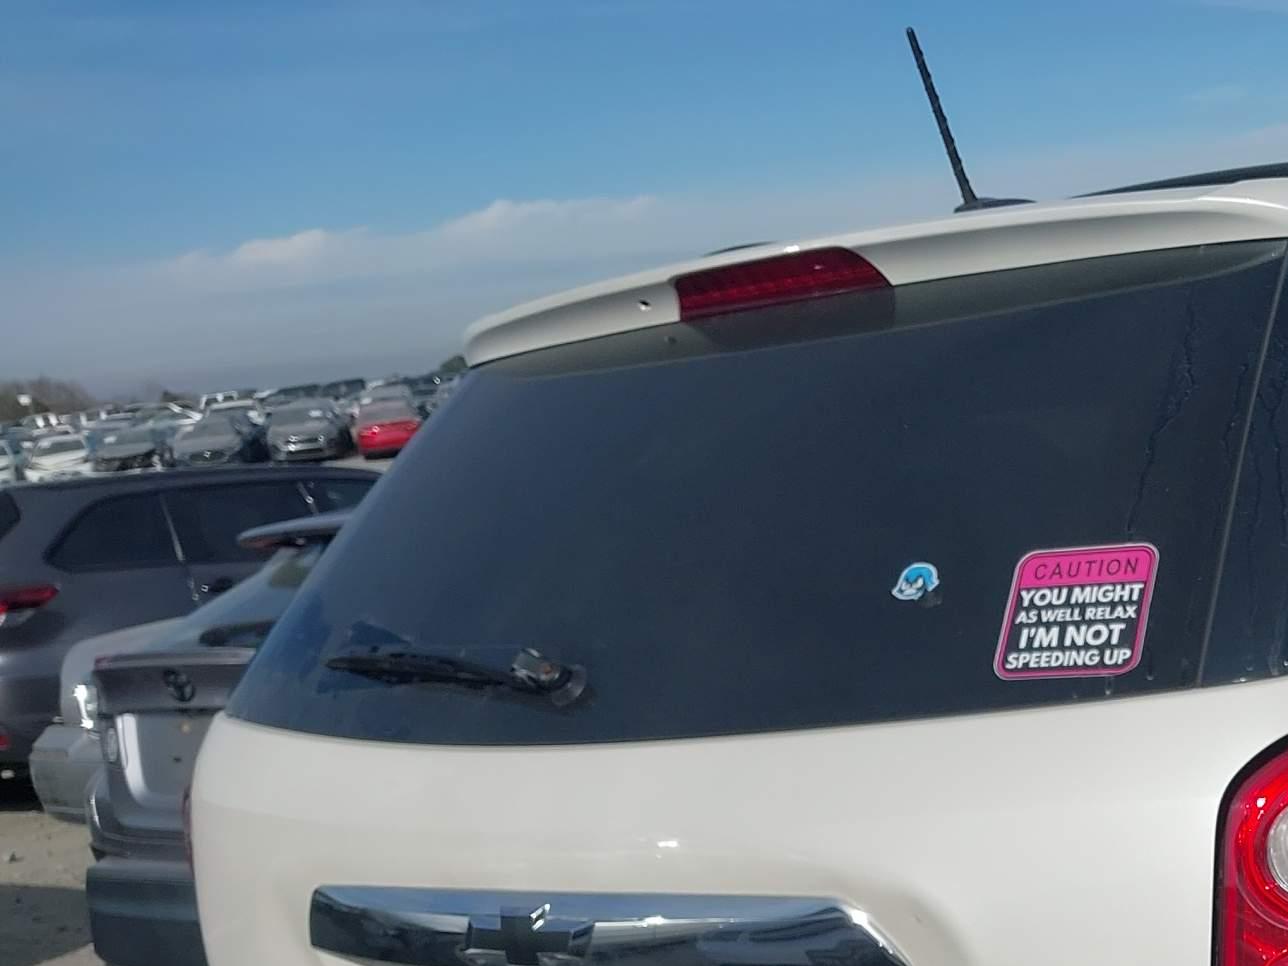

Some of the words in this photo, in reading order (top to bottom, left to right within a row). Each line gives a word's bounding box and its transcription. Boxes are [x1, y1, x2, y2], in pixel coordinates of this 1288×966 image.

[1034, 557, 1140, 581] CAUTION
[1020, 586, 1068, 607] YOU
[1070, 582, 1144, 604] MIGHT
[1015, 610, 1038, 625] AS
[1040, 607, 1082, 622] WELL
[1085, 605, 1138, 621] RELAX
[1018, 626, 1060, 649] I'M
[1063, 623, 1126, 647] NOT
[1005, 650, 1101, 669] SPEEDING
[1103, 648, 1132, 665] UP
